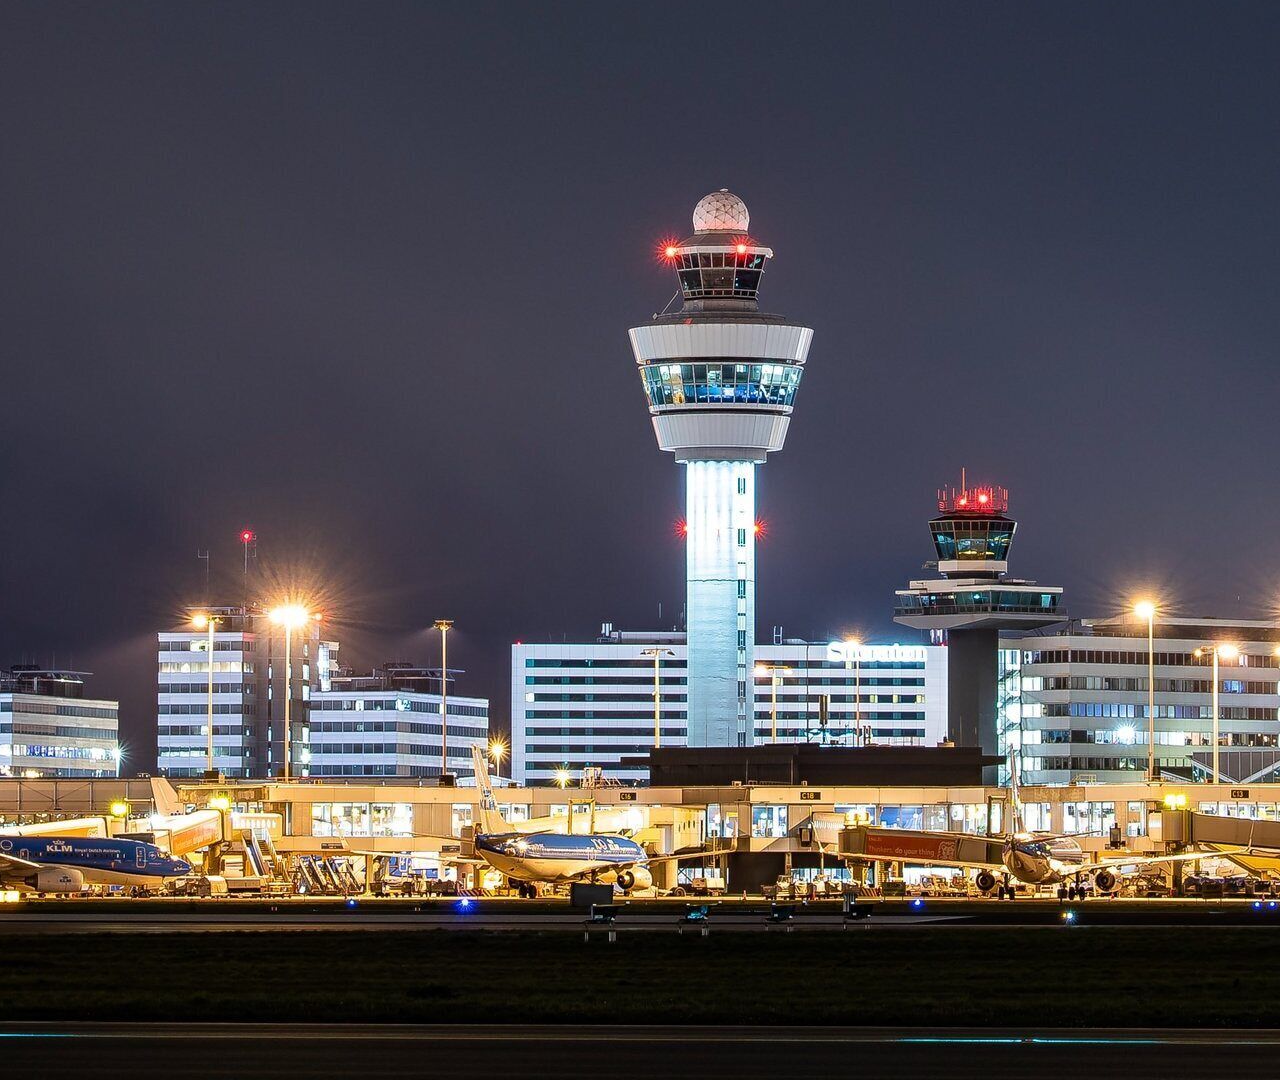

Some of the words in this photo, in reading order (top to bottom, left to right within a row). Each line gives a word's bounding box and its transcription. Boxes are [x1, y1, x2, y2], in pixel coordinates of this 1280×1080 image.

[801, 792, 815, 800] C18
[1232, 790, 1244, 798] C13
[904, 848, 918, 856] your
[919, 848, 935, 857] thing
